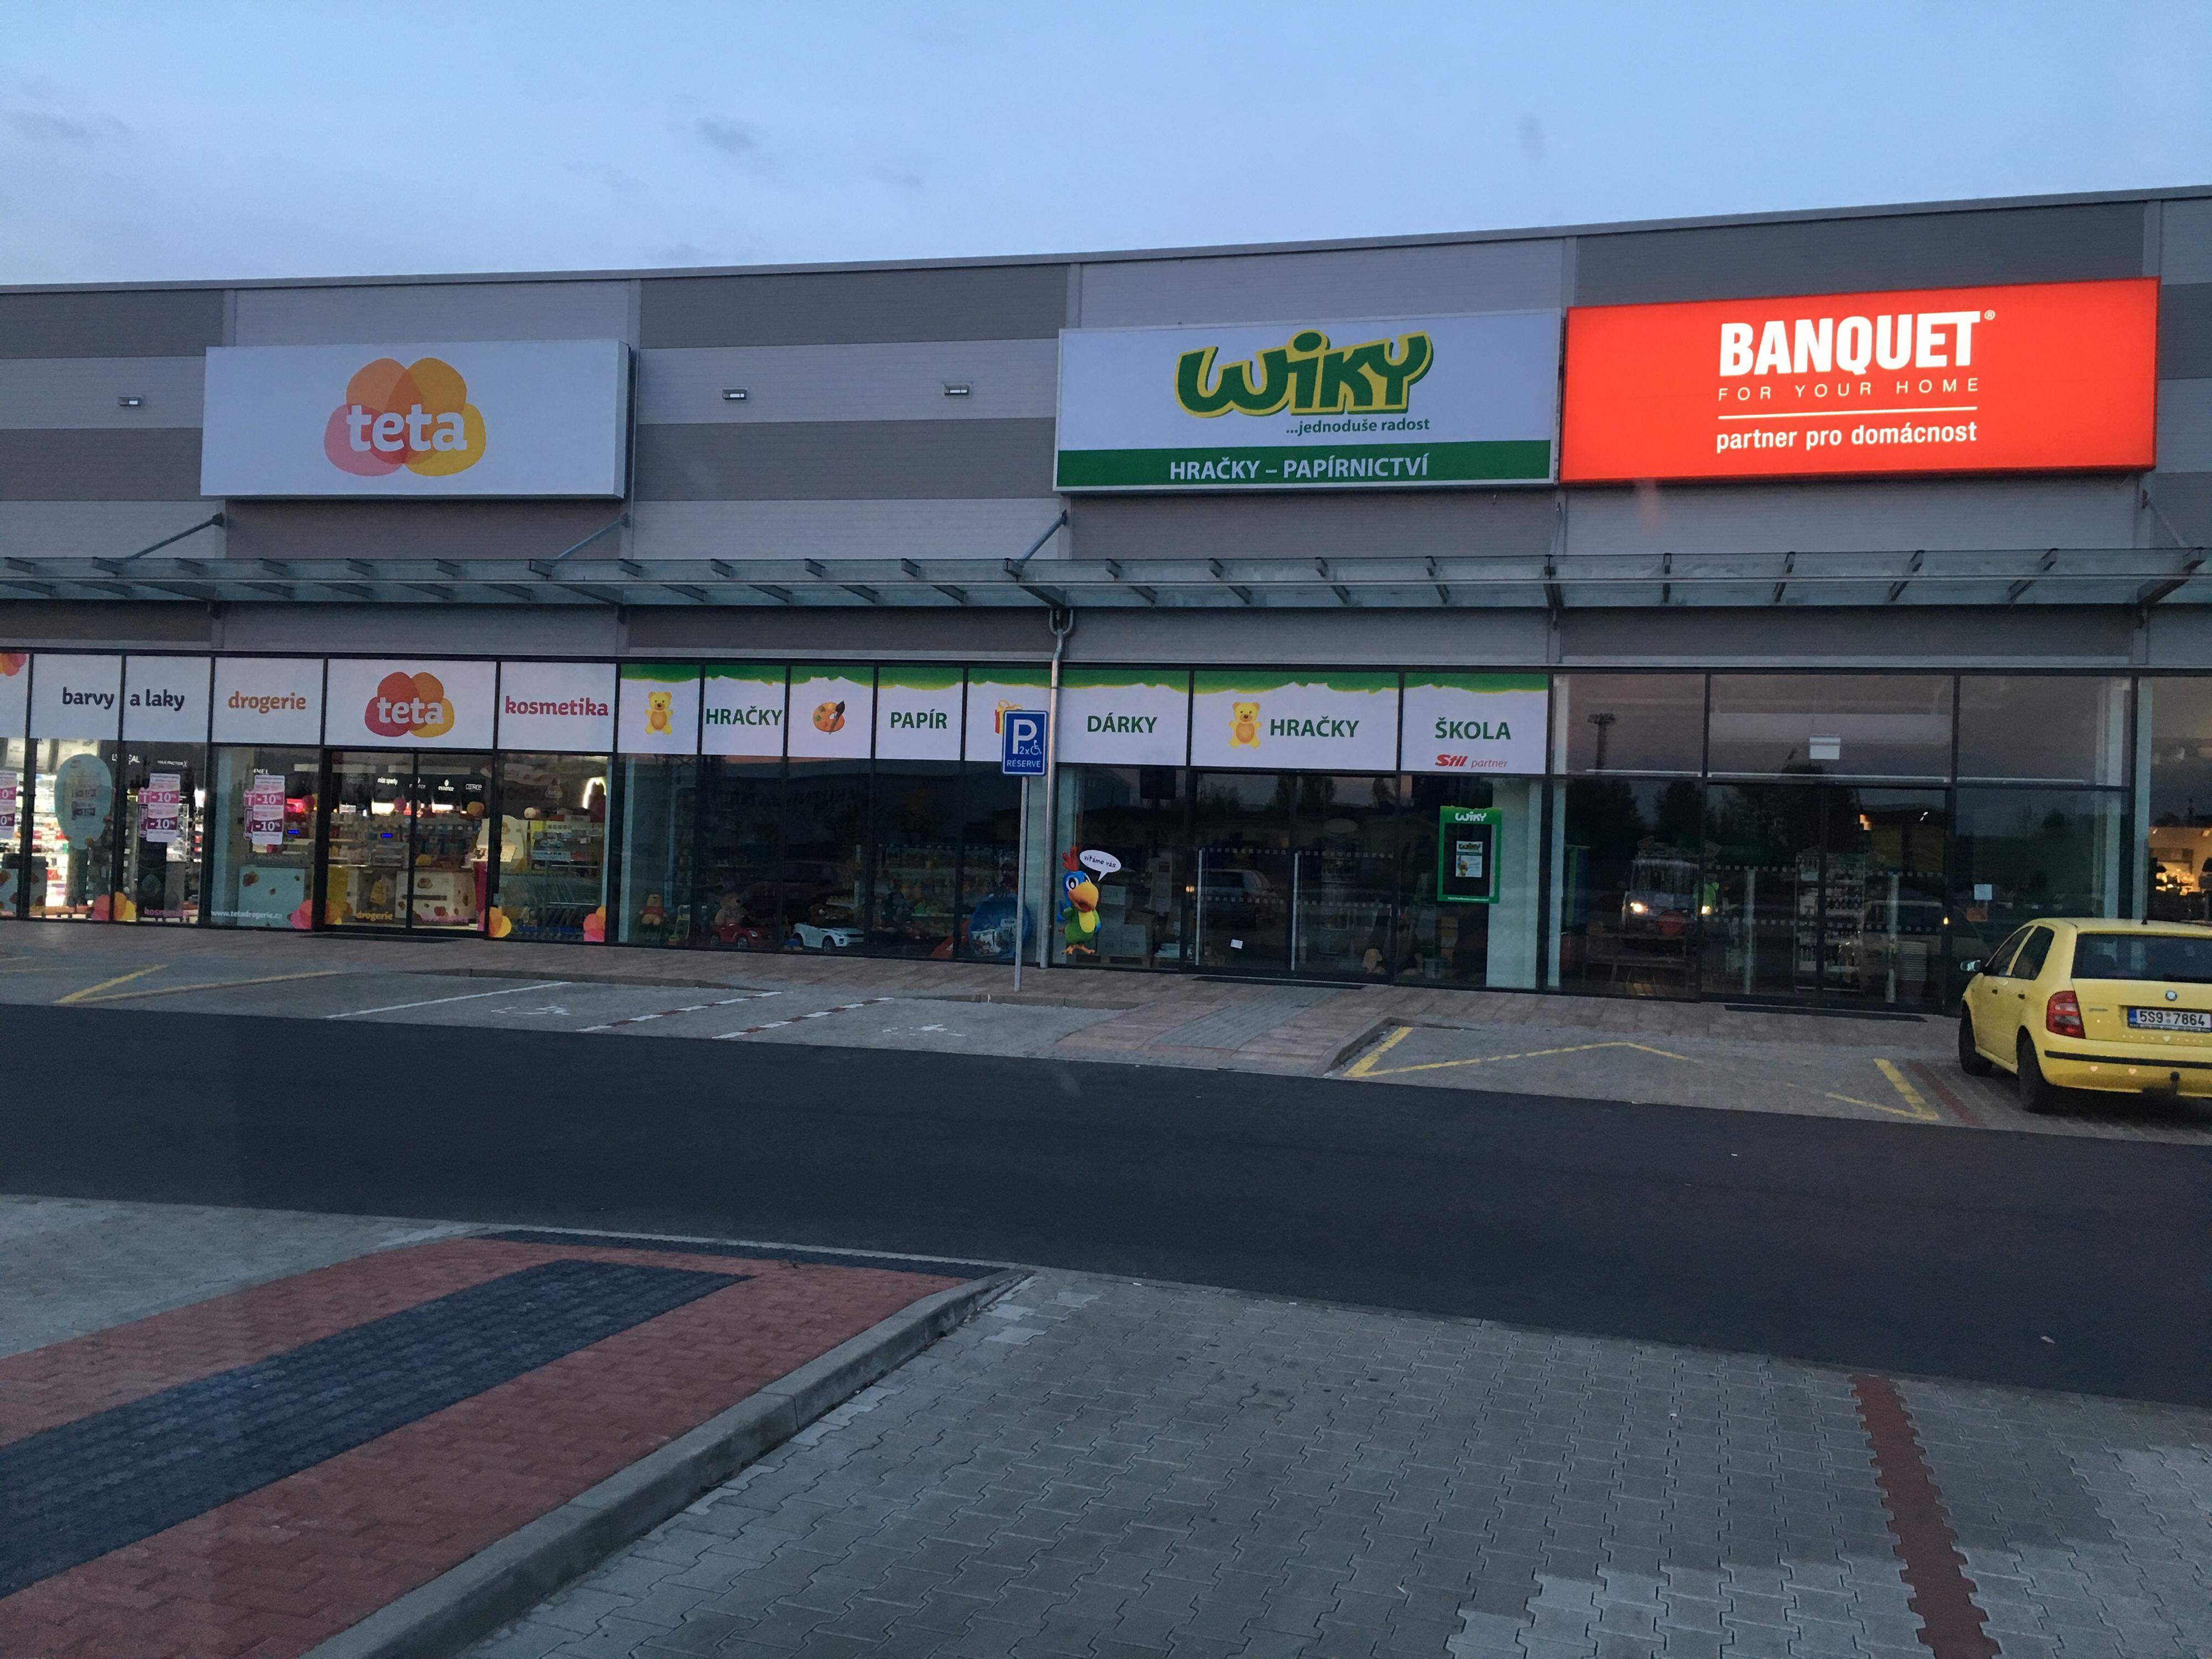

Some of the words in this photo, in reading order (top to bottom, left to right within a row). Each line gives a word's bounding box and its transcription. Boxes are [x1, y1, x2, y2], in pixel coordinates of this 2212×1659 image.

[1719, 310, 1980, 376] BANQUET
[1718, 387, 1771, 401] FOR
[1794, 382, 1871, 398] YOUR
[1896, 378, 1979, 394] HOME
[346, 404, 467, 452] teta
[1381, 418, 1430, 432] radost
[1717, 429, 1797, 453] partner
[1806, 429, 1841, 451] pro
[1851, 421, 1977, 445] domácnost
[1170, 457, 1260, 480] HRAČKY
[1283, 452, 1429, 478] PAPÍRNICTVÍ
[62, 687, 114, 710] barvy
[129, 693, 141, 707] a
[145, 690, 185, 711] laky
[228, 691, 306, 714] drogerie
[377, 696, 444, 724] teta
[505, 696, 608, 717] kosmetika
[706, 706, 782, 726] HRAČKY
[890, 709, 948, 729] PAPÍR
[1087, 712, 1157, 733] DÁRKY
[1270, 716, 1359, 738] HRAČKY
[1013, 719, 1037, 754] P
[1435, 717, 1511, 739] ŠKOLA
[1471, 759, 1508, 769] partner
[356, 911, 393, 922] drogerie
[2140, 1010, 2163, 1024] 5S9
[2173, 1013, 2206, 1026] 7864
